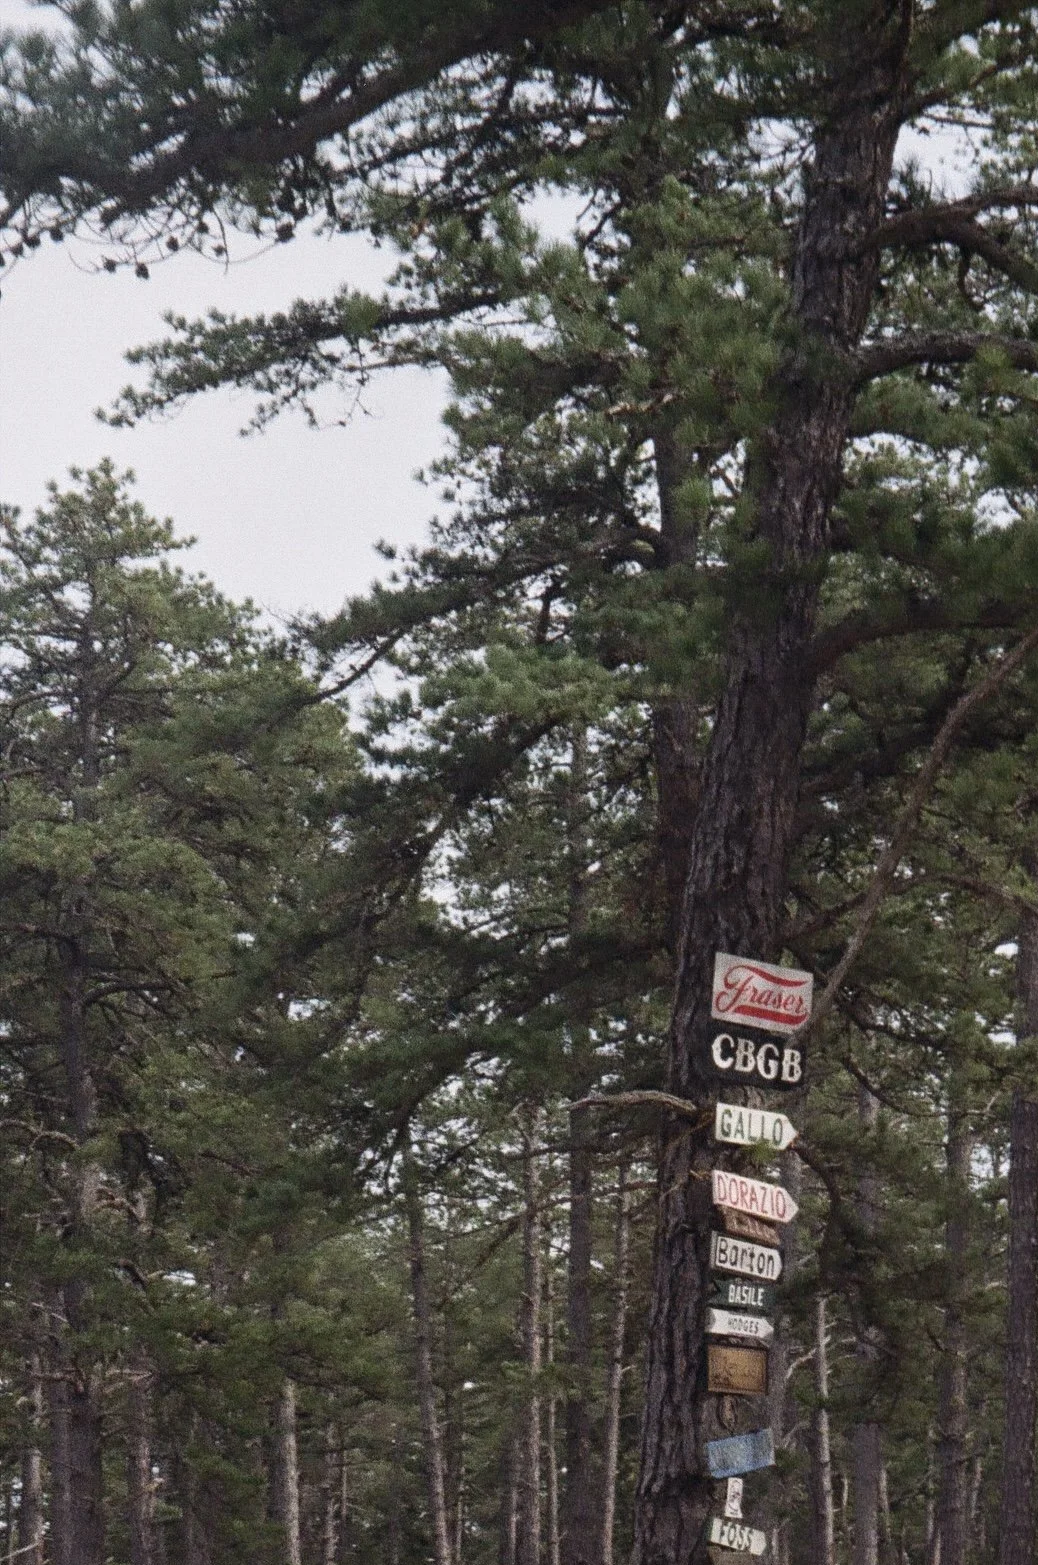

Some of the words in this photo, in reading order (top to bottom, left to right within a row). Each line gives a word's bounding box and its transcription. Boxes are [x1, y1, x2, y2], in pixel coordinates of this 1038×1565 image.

[715, 965, 811, 1025] Fraser
[711, 1033, 802, 1083] CBGB
[719, 1107, 784, 1147] GALLO
[717, 1238, 776, 1277] Barton
[728, 1284, 765, 1306] BASILE
